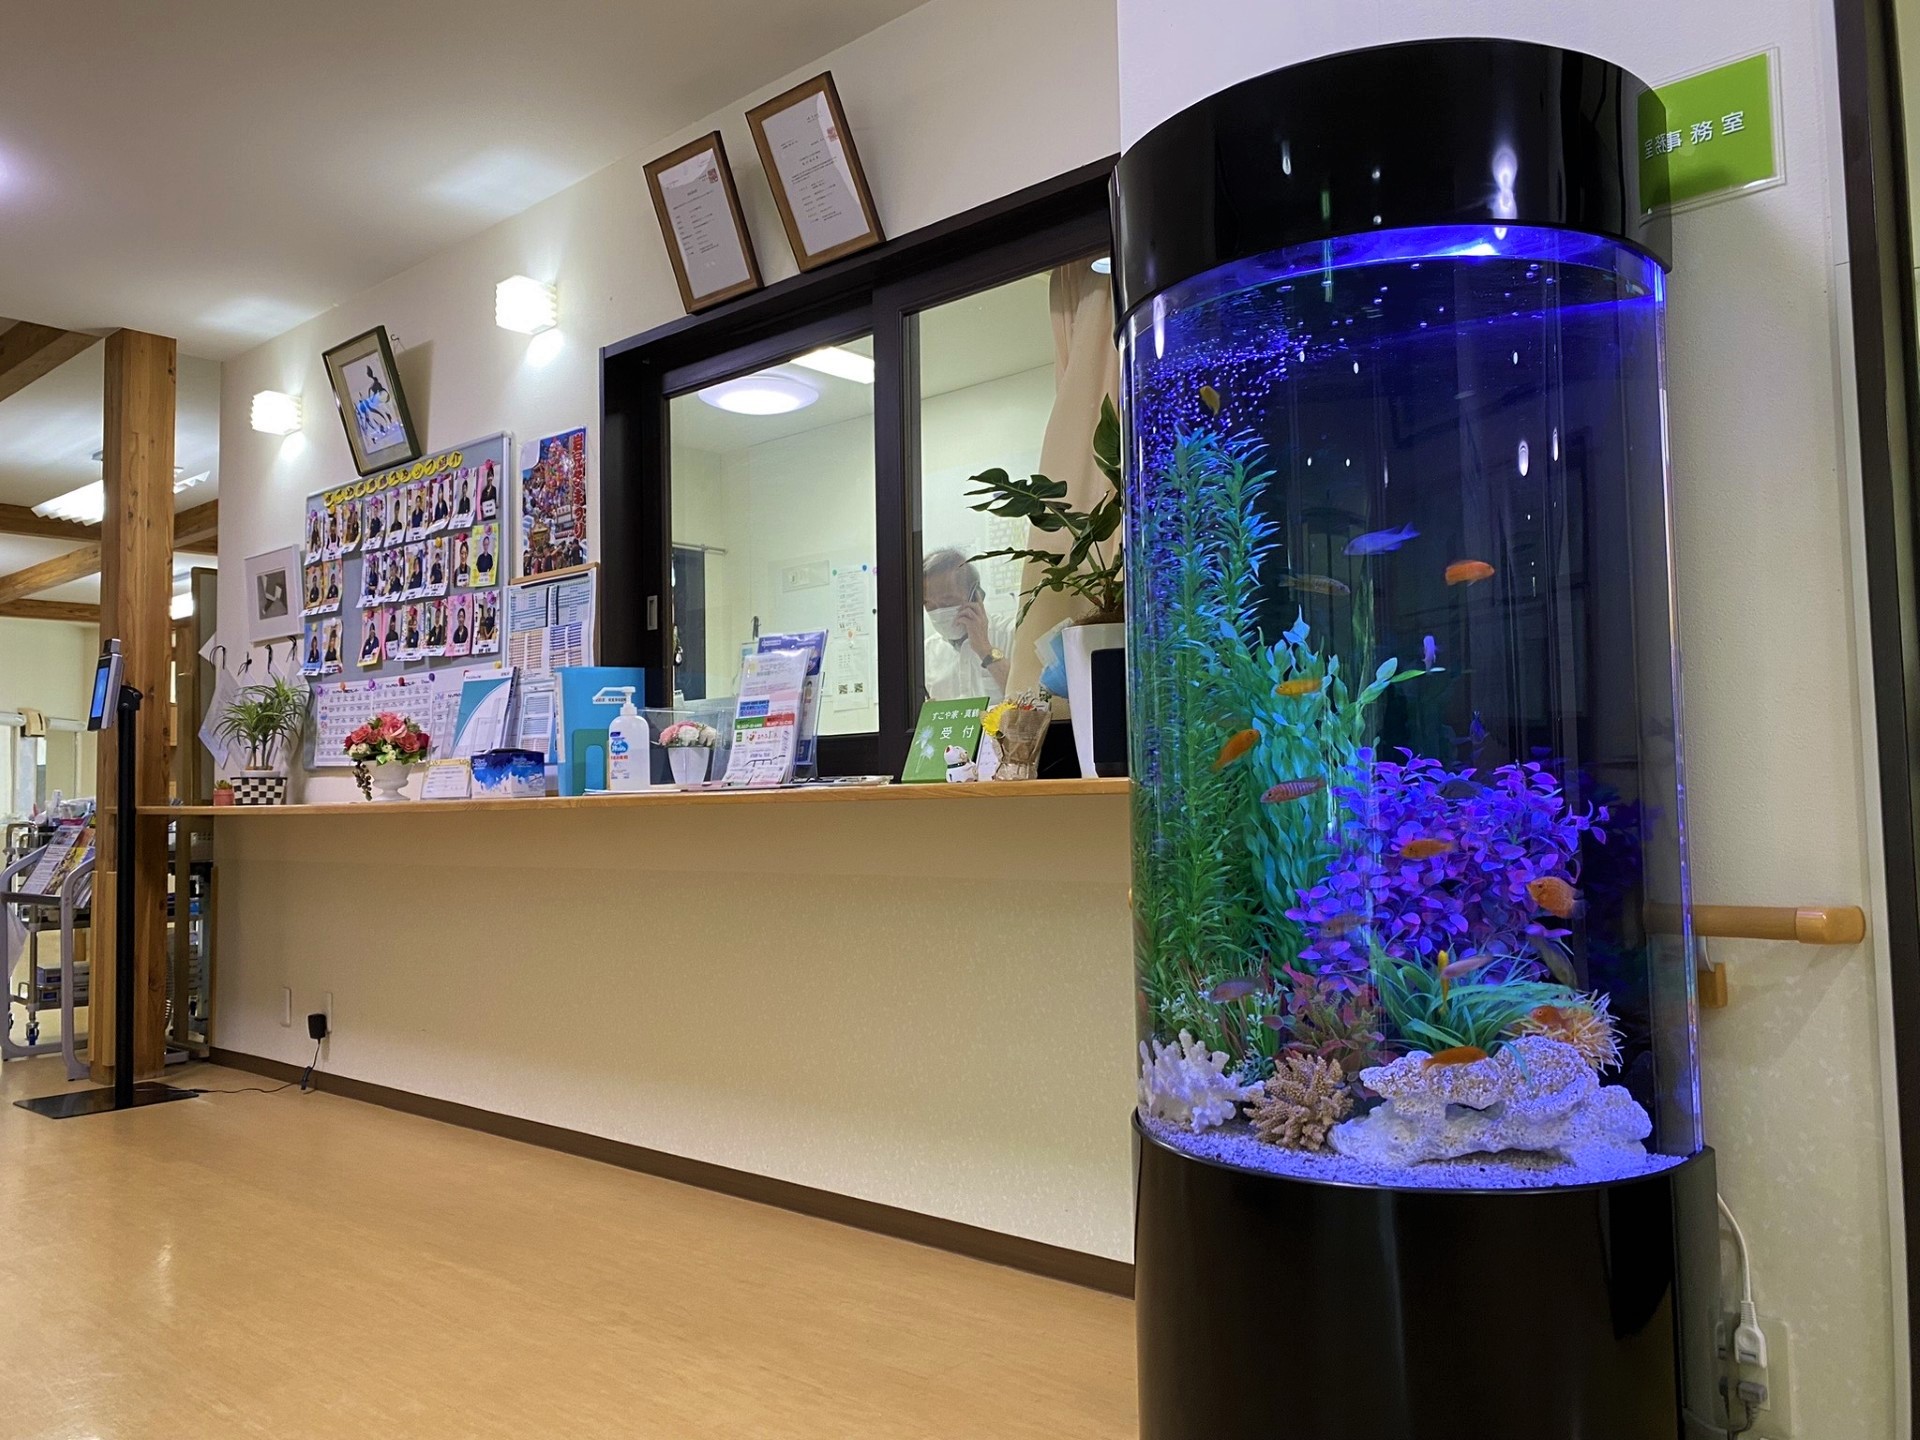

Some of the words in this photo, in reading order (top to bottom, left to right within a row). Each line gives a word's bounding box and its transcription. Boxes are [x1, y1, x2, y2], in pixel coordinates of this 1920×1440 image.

[1666, 110, 1745, 153] 事務室
[939, 725, 975, 740] 受付
